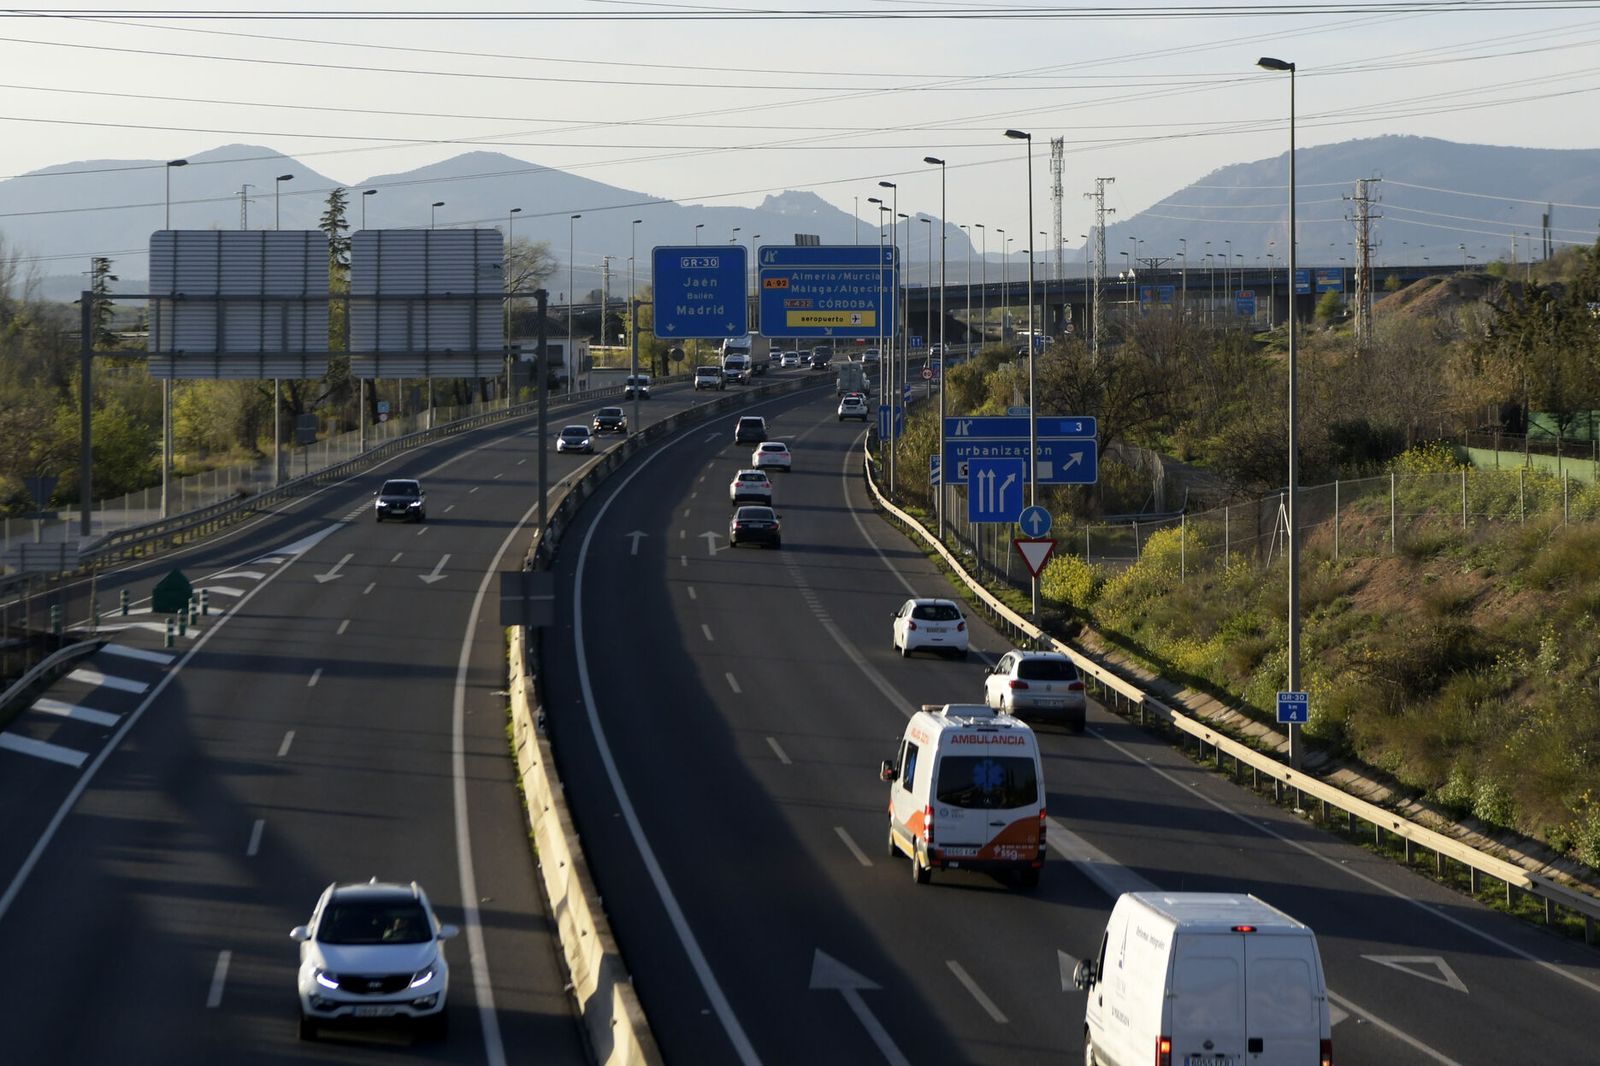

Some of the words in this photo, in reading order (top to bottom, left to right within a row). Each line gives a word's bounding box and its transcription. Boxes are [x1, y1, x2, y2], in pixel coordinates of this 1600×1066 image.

[885, 252, 893, 260] 3
[682, 258, 717, 267] GR-30
[683, 277, 717, 288] Jaén
[766, 279, 787, 287] A-92
[687, 292, 714, 300] Bailén
[818, 298, 874, 308] CÓRDOBA
[676, 304, 724, 315] Madrid
[1076, 422, 1083, 432] 3
[956, 444, 1053, 456] urbanizacón
[1289, 711, 1297, 720] 4
[951, 735, 1025, 746] AMBULANCIA
